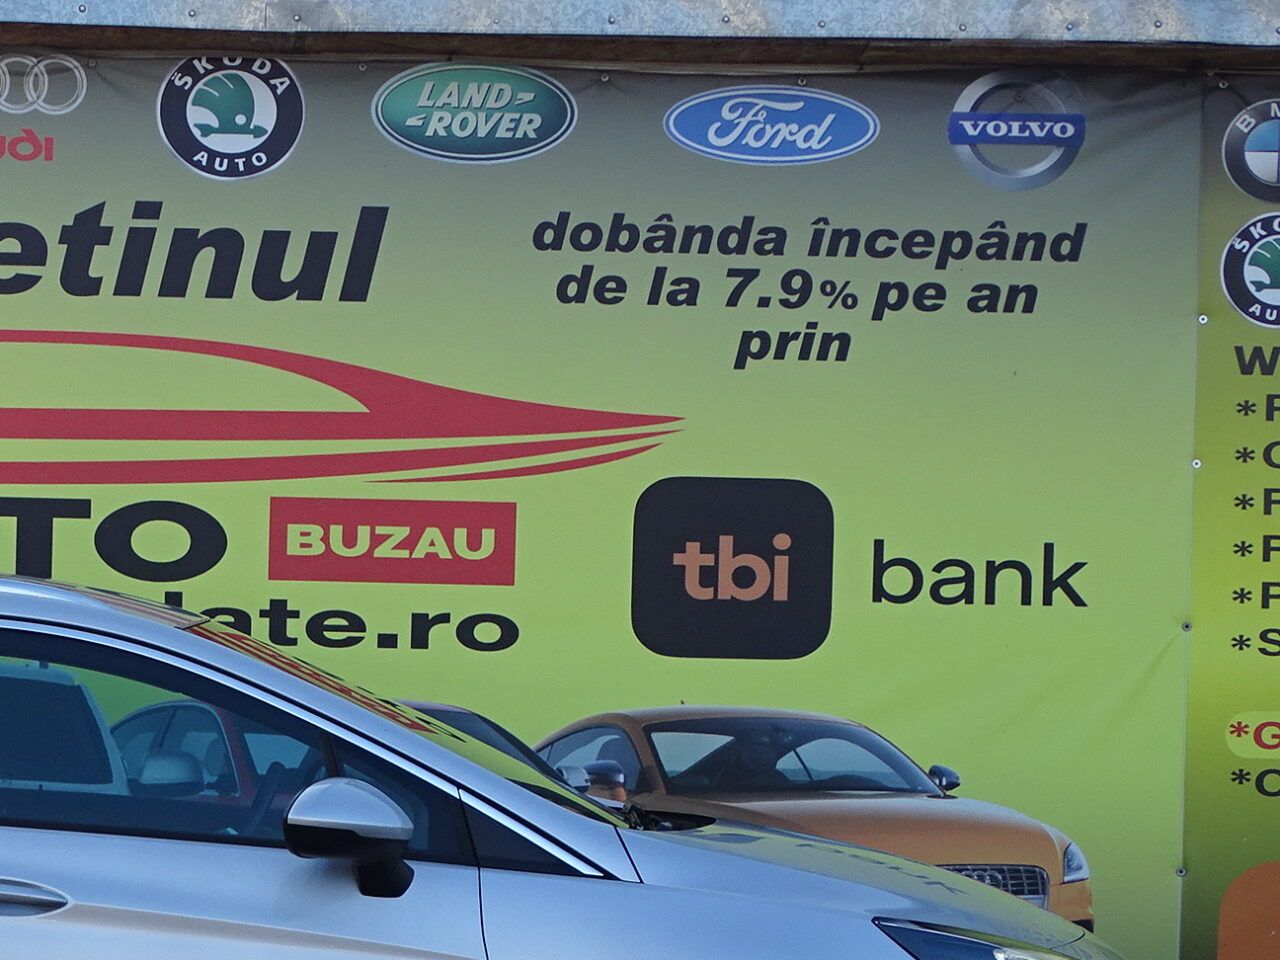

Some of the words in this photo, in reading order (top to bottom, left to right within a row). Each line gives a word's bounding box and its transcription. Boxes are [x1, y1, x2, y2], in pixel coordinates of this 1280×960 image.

[707, 97, 837, 151] Ford
[959, 120, 1077, 139] VOLVO
[193, 151, 267, 172] AUTO
[531, 210, 789, 257] dobânda
[807, 216, 1090, 270] începând
[556, 265, 628, 305] de
[646, 266, 701, 307] la
[724, 267, 859, 311] 7.9%
[870, 280, 948, 321] pe
[966, 282, 1039, 315] an
[733, 321, 853, 370] prin
[286, 522, 496, 562] BUZAU
[672, 530, 792, 603] tbi
[869, 538, 1089, 608] bank
